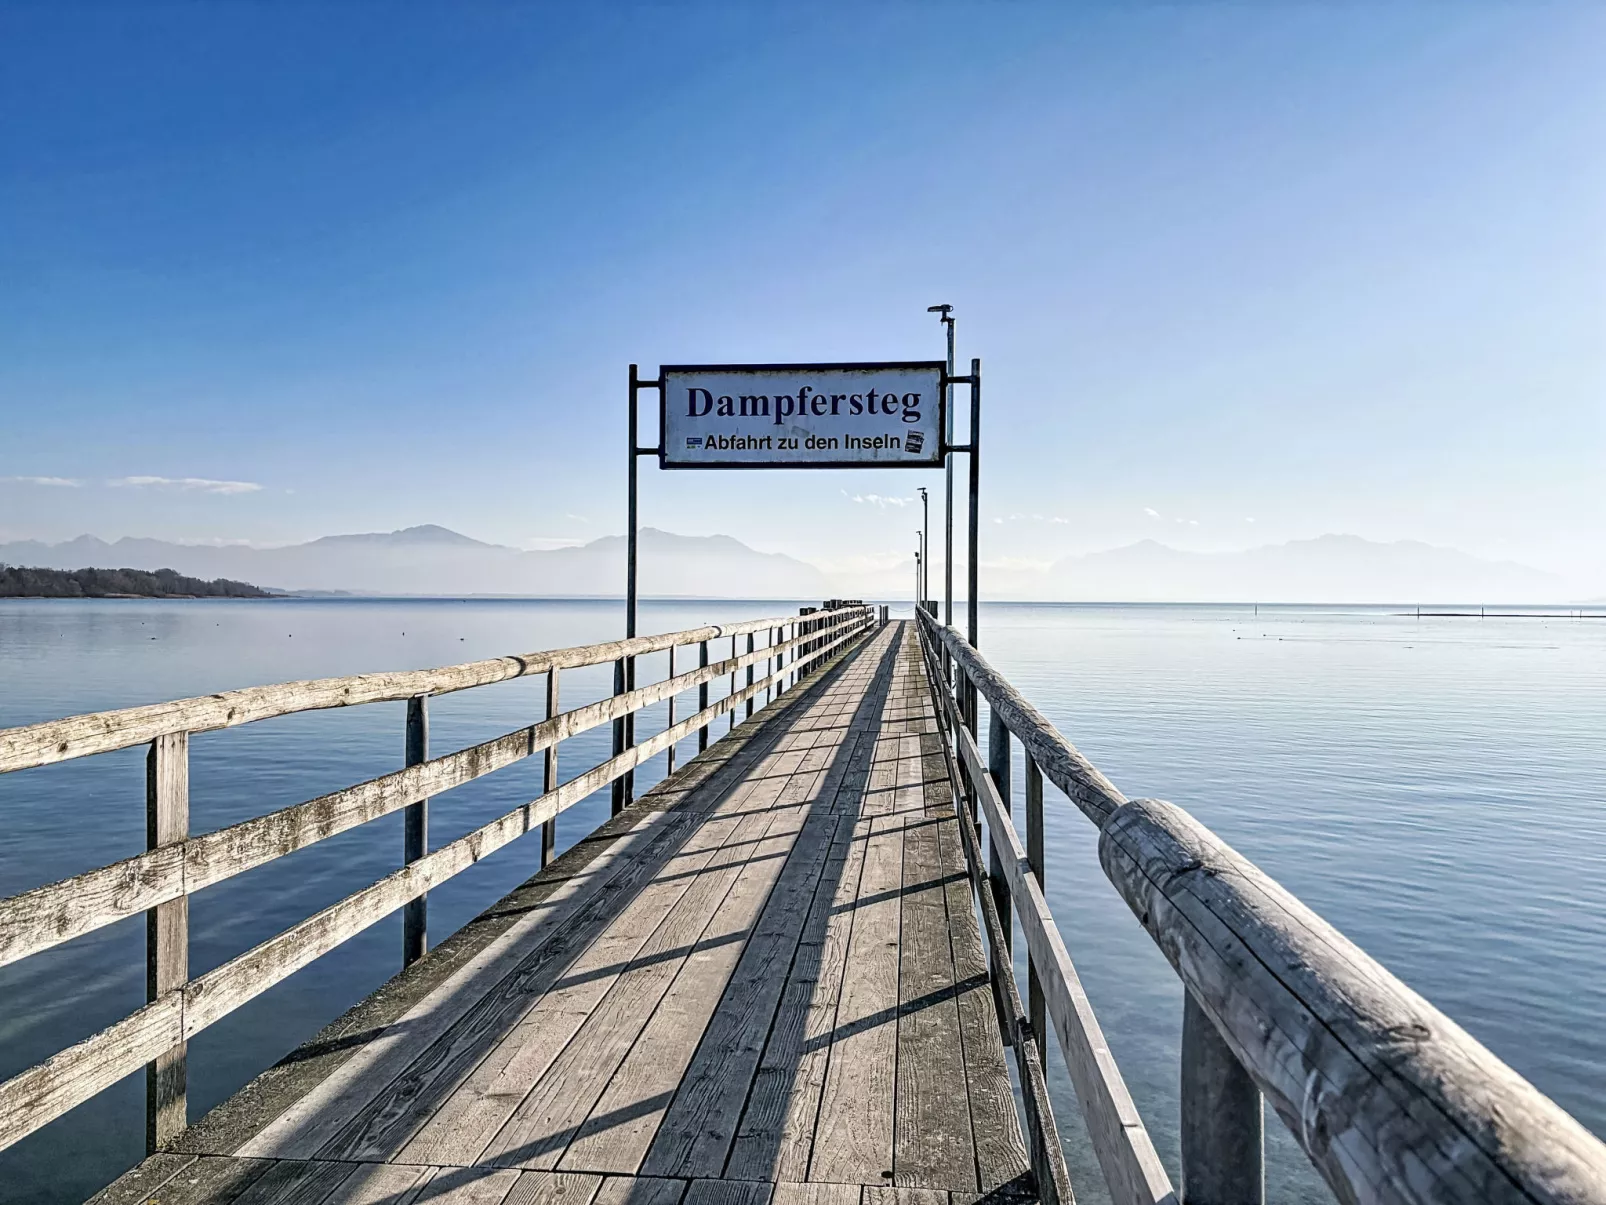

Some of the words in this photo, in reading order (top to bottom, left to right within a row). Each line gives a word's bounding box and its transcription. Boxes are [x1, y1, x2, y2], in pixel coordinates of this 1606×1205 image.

[686, 386, 922, 425] Dampfersteg
[704, 434, 772, 450] Abfahrt
[777, 438, 799, 450] zu
[804, 434, 839, 450] den
[845, 433, 901, 449] Inseln
